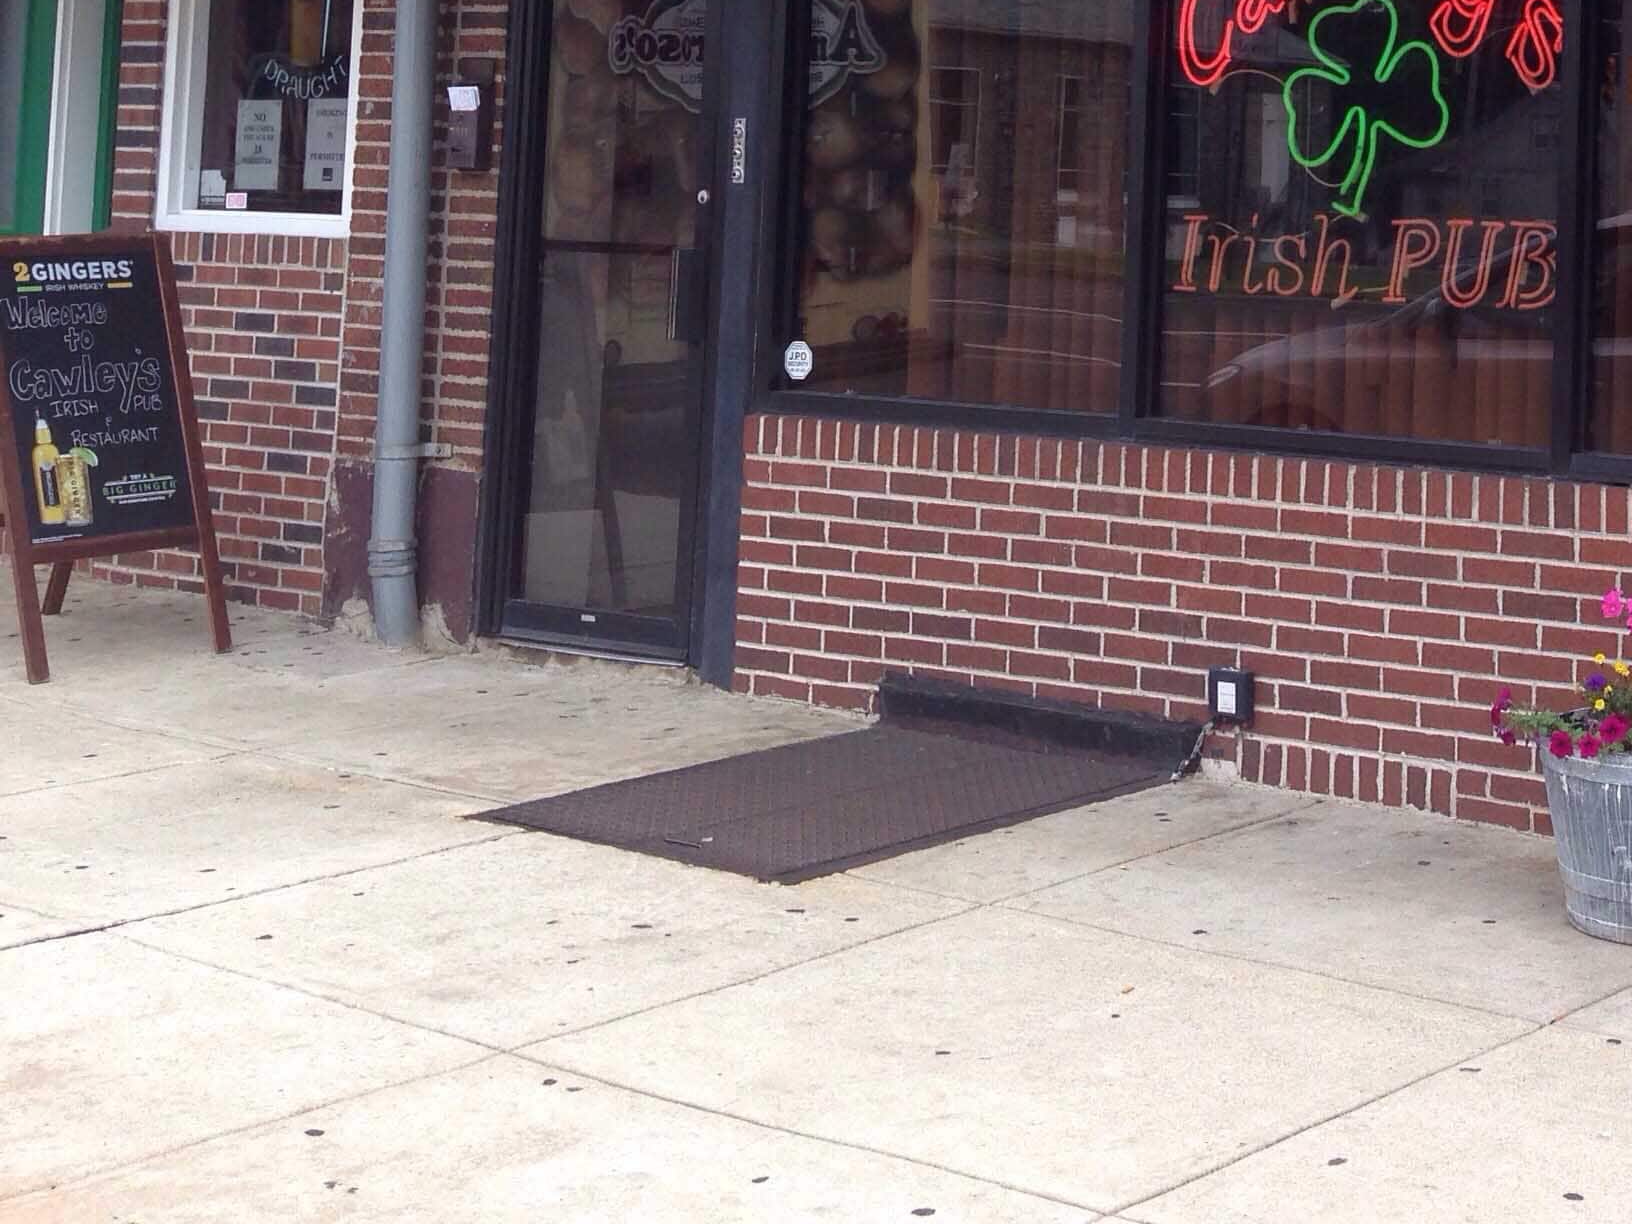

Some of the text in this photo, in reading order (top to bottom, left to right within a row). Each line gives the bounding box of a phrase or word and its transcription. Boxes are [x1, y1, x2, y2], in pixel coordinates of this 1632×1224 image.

[264, 56, 346, 100] DRAUGHT
[13, 260, 132, 282] 2 GINGERS
[1173, 213, 1557, 310] Irish PUB
[64, 327, 94, 352] to
[10, 349, 161, 413] Cawley's
[49, 394, 162, 417] IRISH PUB
[71, 427, 159, 448] RESTAURANT
[102, 480, 177, 496] BIG GINGER
